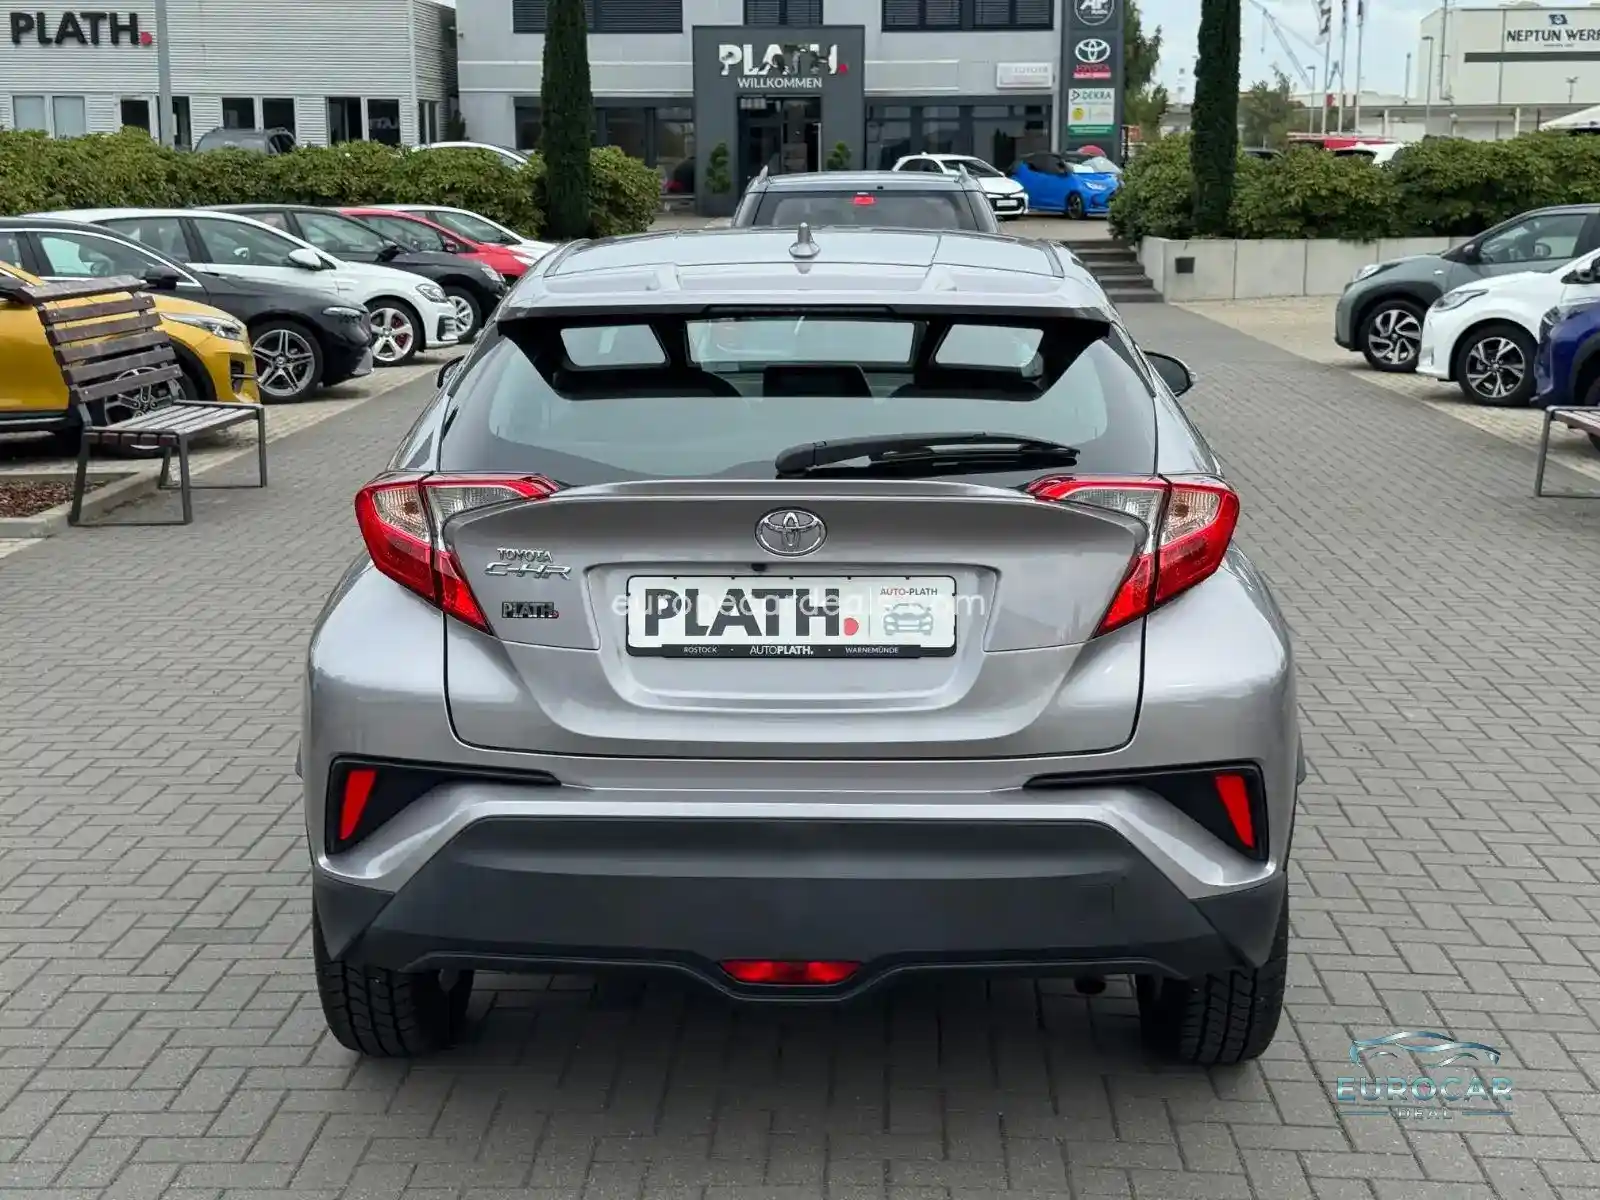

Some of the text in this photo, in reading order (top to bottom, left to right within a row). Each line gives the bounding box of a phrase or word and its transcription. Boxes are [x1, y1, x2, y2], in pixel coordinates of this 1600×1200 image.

[10, 11, 153, 46] PLATH.
[1507, 29, 1560, 41] NEPTUN
[718, 43, 848, 76] PLAH.
[737, 77, 823, 89] WILLKOMMEN
[1081, 90, 1112, 100] DEKRA
[497, 547, 554, 563] TOYOTA
[485, 562, 572, 580] C-HR
[880, 588, 938, 596] AUTO-PLATH
[644, 588, 859, 637] PLATH.
[683, 645, 899, 656] ROSTOCK AUTOPLATH. WARNEMÜNDE
